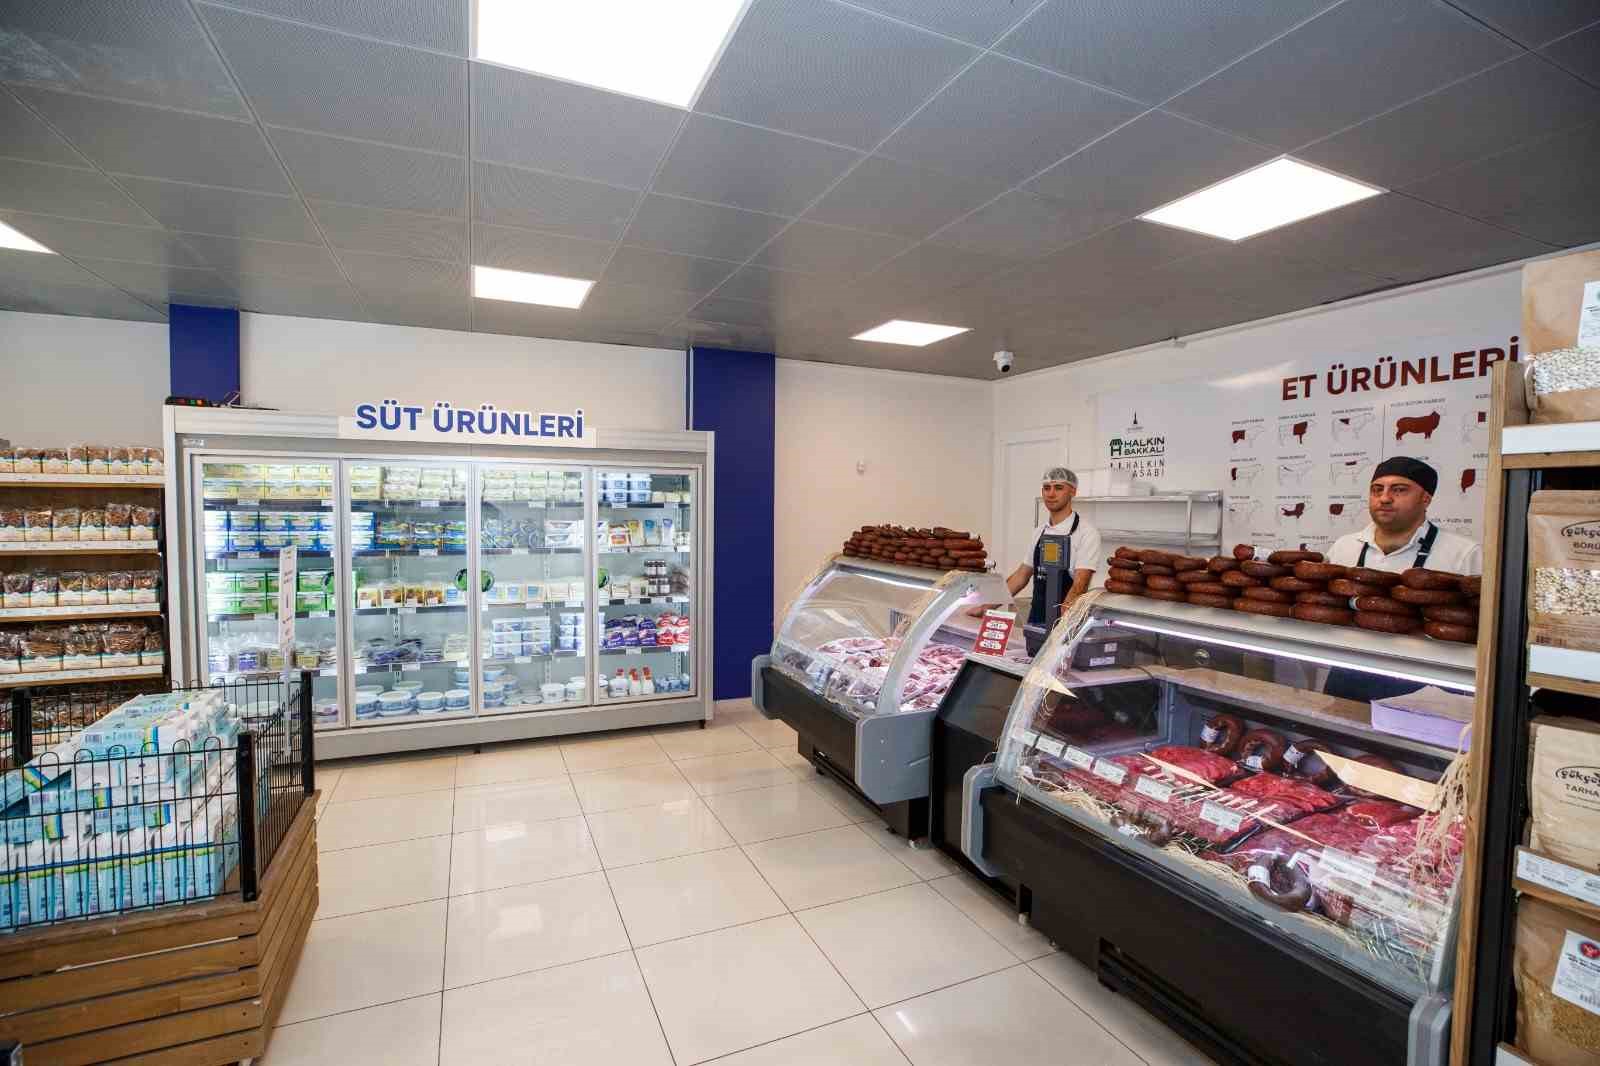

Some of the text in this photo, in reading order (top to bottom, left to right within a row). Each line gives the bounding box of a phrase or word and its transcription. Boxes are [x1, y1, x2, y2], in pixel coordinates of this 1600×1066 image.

[1282, 336, 1519, 401] ET ÜRÜNLERİ
[356, 399, 583, 438] SÜT ÜRÜNLERİ
[1124, 437, 1165, 448] HALKIN
[1124, 446, 1165, 456] BAKKALI
